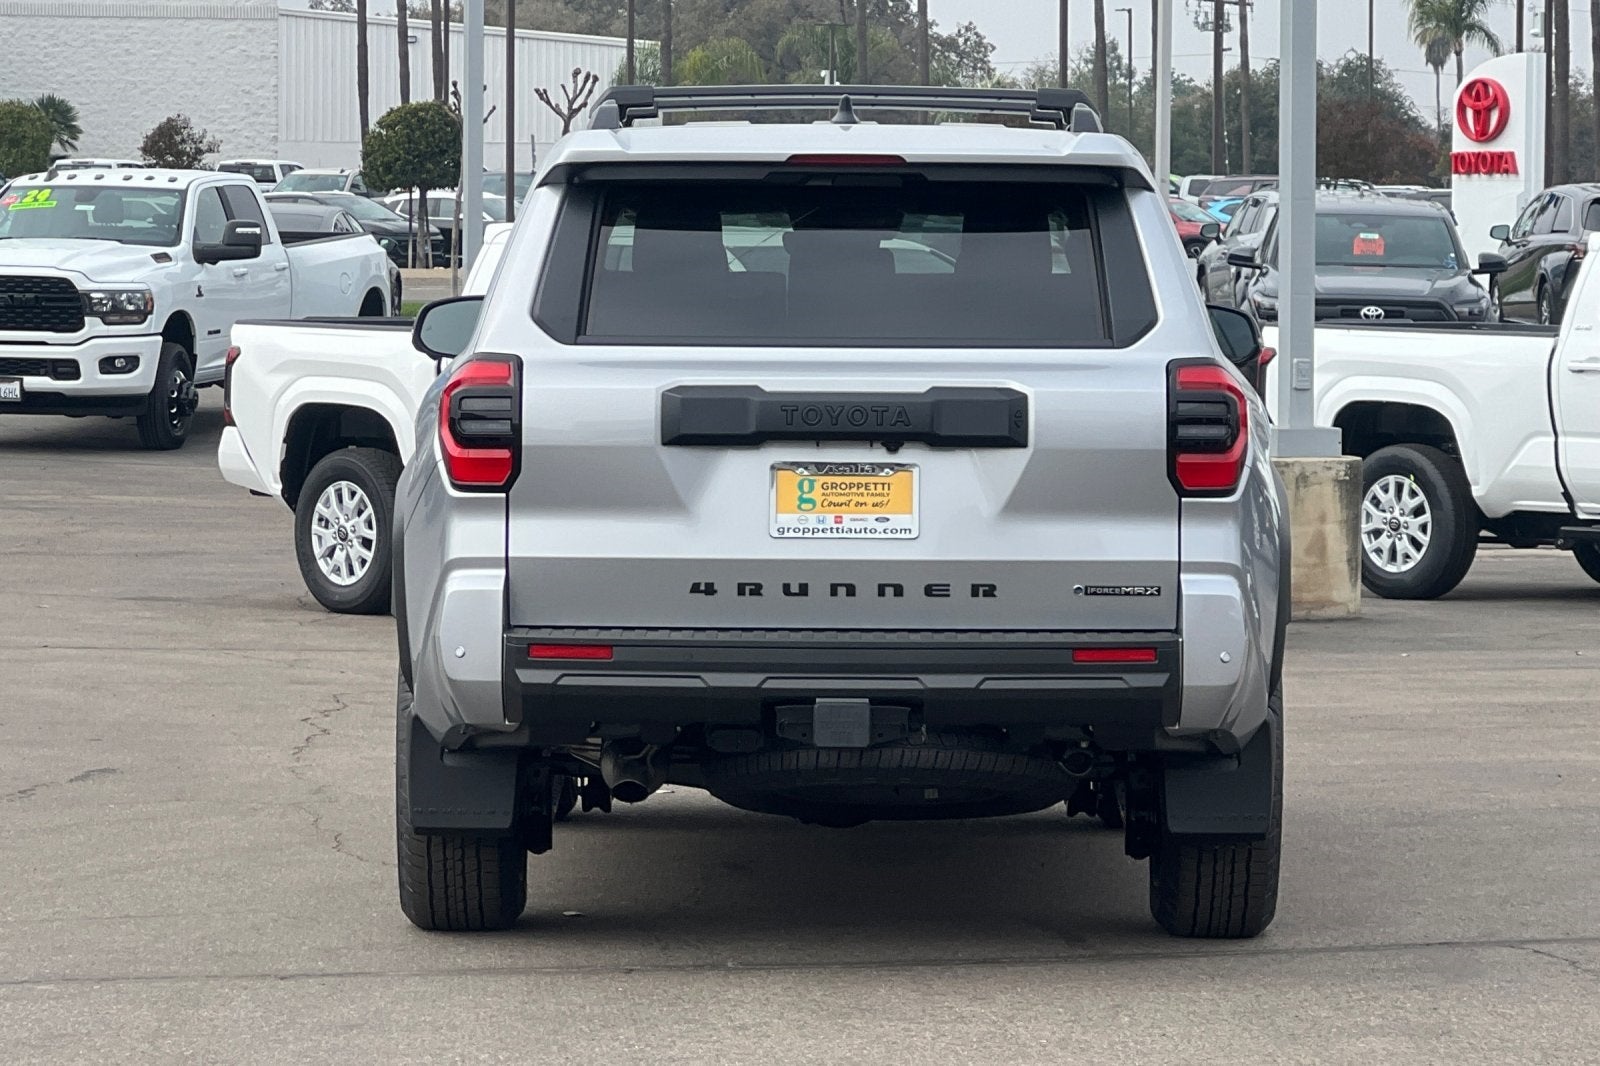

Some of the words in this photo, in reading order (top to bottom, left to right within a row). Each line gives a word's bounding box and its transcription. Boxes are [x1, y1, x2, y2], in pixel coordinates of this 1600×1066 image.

[1449, 151, 1519, 175] TOYOTA
[781, 405, 912, 427] TOYOTA
[815, 464, 877, 475] Visalia
[821, 482, 891, 491] GROPPETTI
[821, 498, 852, 509] Count
[872, 499, 890, 508] us!
[777, 526, 912, 536] groppettiauto.com
[689, 582, 998, 597] 4RUNNER
